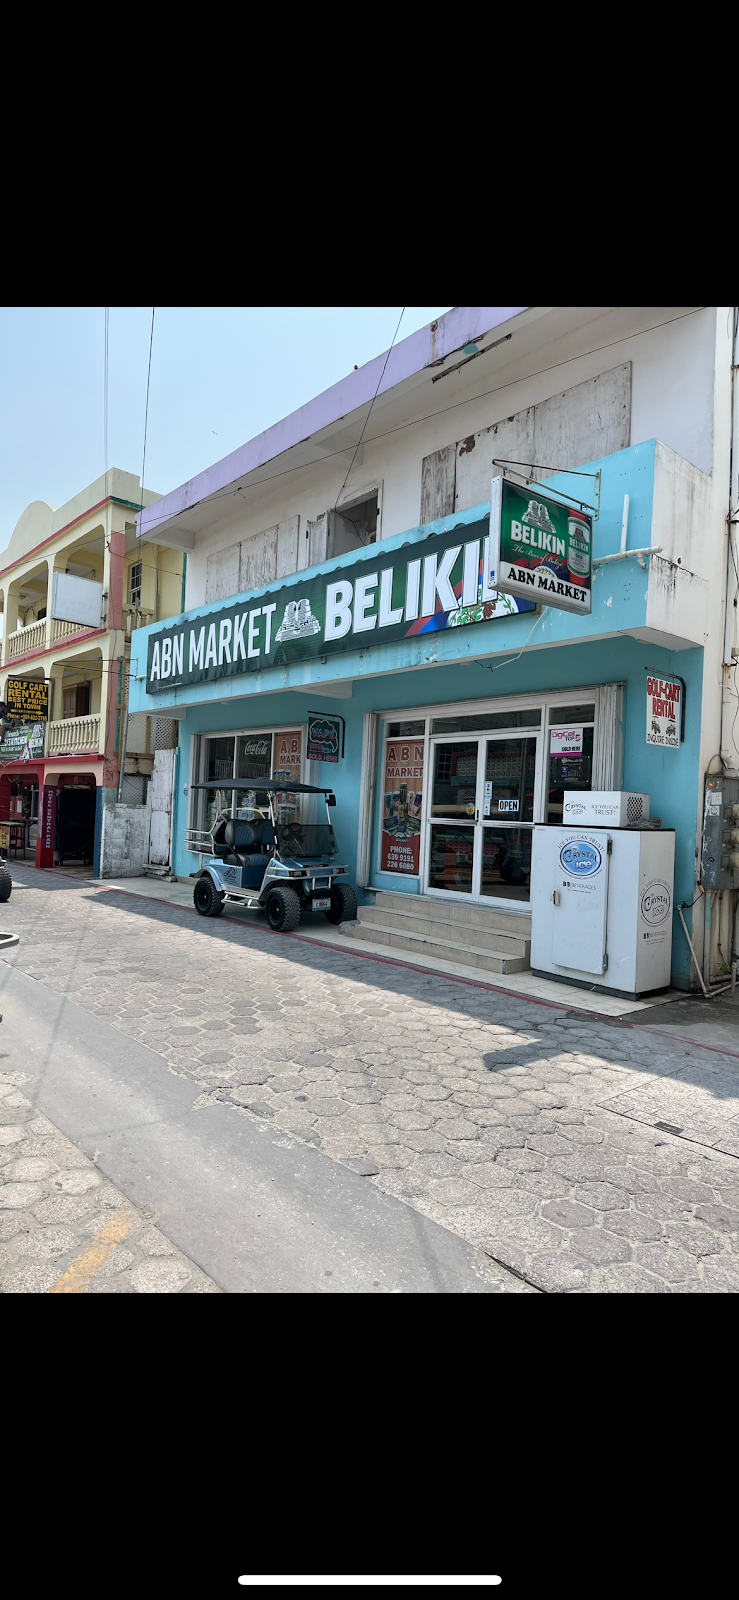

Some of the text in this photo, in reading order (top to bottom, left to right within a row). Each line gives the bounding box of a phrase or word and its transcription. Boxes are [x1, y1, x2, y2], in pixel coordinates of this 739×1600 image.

[511, 520, 565, 557] BELIKIN
[569, 536, 588, 553] BELIKIN
[512, 544, 524, 553] The
[525, 550, 539, 559] Beer
[508, 567, 587, 602] ABN MARKET
[150, 632, 184, 681] ABN
[189, 602, 277, 673] MARKET
[8, 681, 48, 692] GOLF CART
[647, 677, 680, 702] GOLF-CART
[8, 689, 47, 700] RENTAL
[652, 698, 675, 719] RENTAL
[387, 766, 423, 778] MARKET
[500, 801, 518, 811] OPEN
[390, 846, 413, 854] PHONE:
[590, 837, 605, 852] TRUST!
